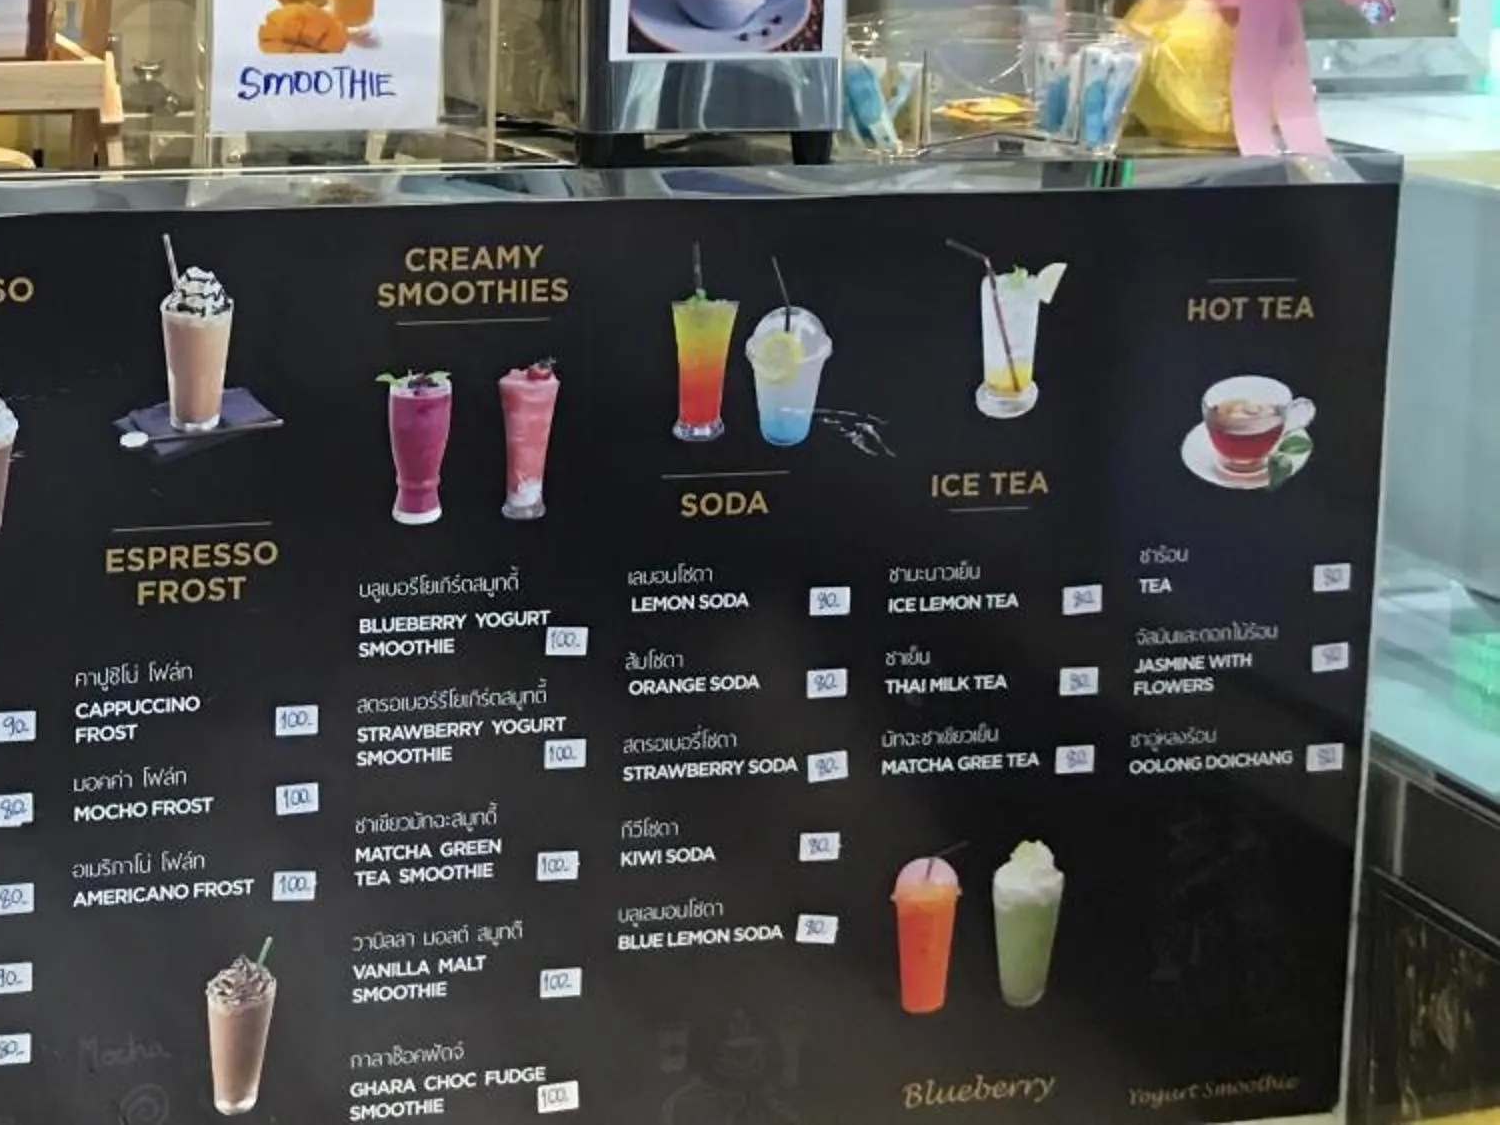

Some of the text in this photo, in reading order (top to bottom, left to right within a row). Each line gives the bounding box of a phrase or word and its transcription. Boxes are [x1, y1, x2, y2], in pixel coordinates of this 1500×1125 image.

[405, 245, 543, 271] CREAMY
[378, 278, 568, 307] SMOOTHIES
[1188, 296, 1314, 321] HOT TEA
[932, 471, 1048, 497] ICE TEA
[681, 491, 768, 517] SODA
[106, 541, 278, 572] ESPRESSO
[138, 577, 246, 605] FROST
[1140, 579, 1172, 593] TEA
[632, 593, 748, 612] LEMON SODA
[889, 593, 1018, 612] ICE LEMON TEA
[360, 610, 550, 633] BLUEBERRY YOGURT
[359, 638, 454, 657] SMOOTHIE
[1135, 653, 1252, 673] JASMINE WITH
[629, 675, 760, 695] ORANGE SODA
[885, 675, 1007, 693] THAI MILK TEA
[1134, 677, 1214, 695] FLOWERS
[76, 696, 200, 719] CAPPUCCINO
[76, 724, 138, 743] FROST
[357, 717, 566, 743] STRAWBERRY YOGURT
[357, 746, 452, 766] SMOOTHIE
[882, 753, 1039, 775] MATCHA GREE TEA
[1129, 750, 1293, 774] OOLONG DOICHANG
[623, 757, 798, 781] STRAWBERRY SODA
[74, 797, 214, 821] MOCHO FROST
[356, 839, 501, 863] MATCHA GREEN
[621, 847, 715, 866] KIWI SODA
[354, 863, 493, 886] TEA SMOOTHIE
[73, 879, 254, 907] AMERICANO FROST
[618, 925, 783, 950] BLUE LEMON SODA
[353, 955, 486, 979] VANILLA MALT
[353, 981, 446, 1003] SMOOTHIE
[350, 1067, 545, 1097] GHARA CHOC FUDGE
[903, 1073, 1055, 1110] Blueberry
[350, 1098, 444, 1121] SMOOTHIE
